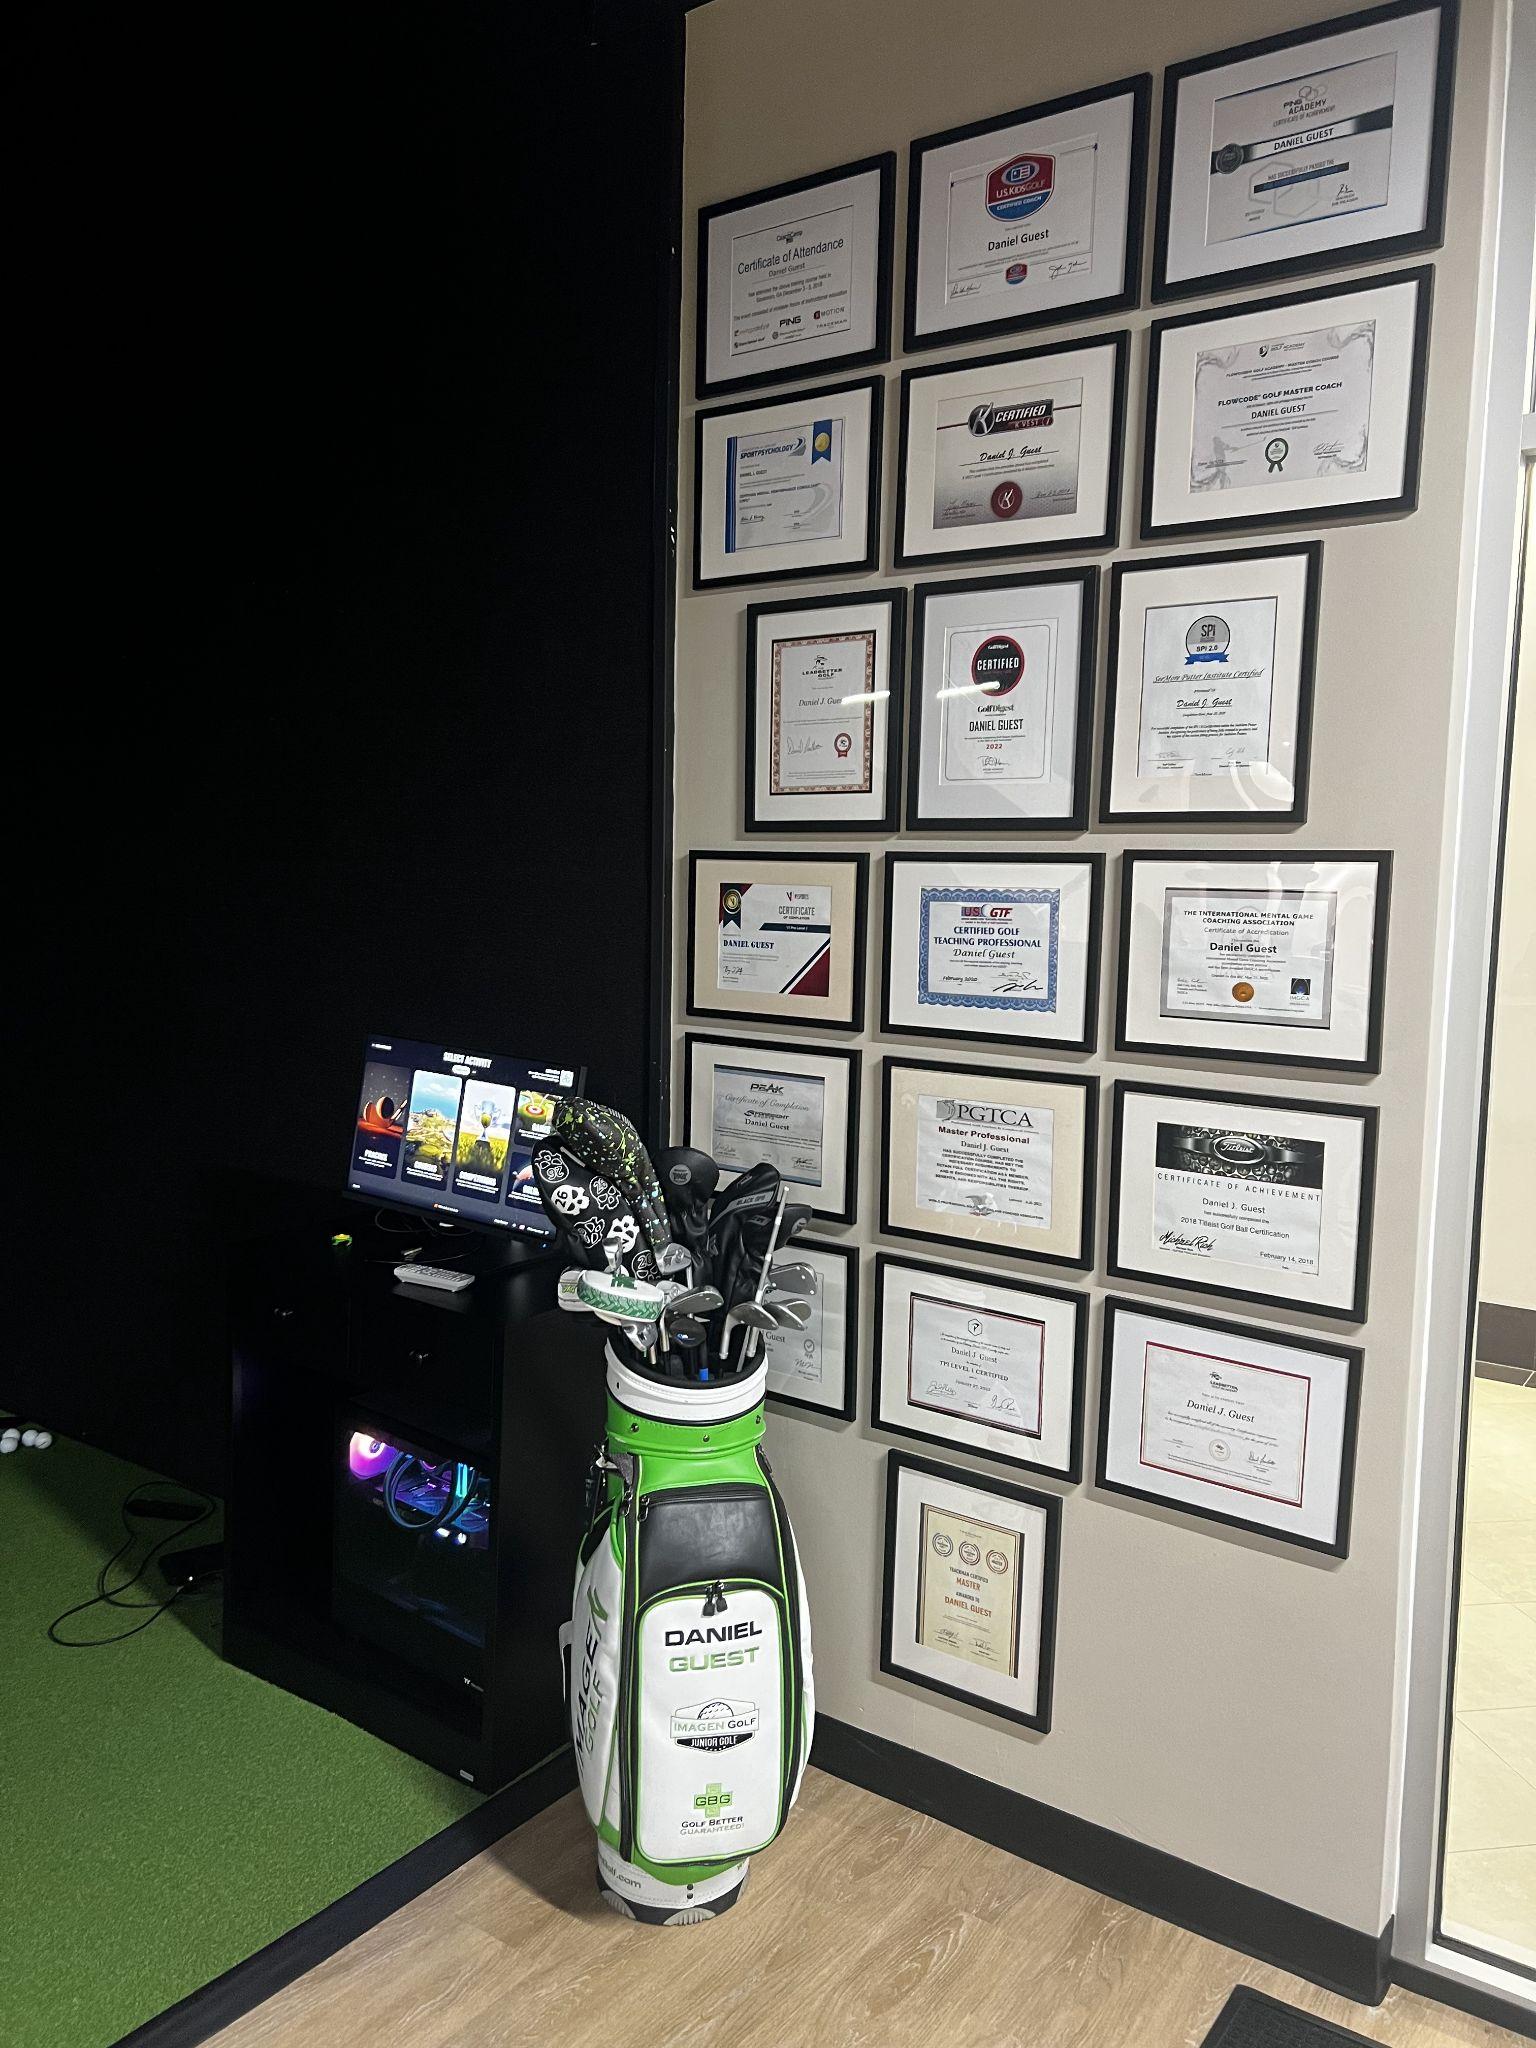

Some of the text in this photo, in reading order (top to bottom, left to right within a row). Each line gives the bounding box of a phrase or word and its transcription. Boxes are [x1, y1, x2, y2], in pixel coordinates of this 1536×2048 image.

[1283, 99, 1302, 109] PING
[1289, 99, 1327, 115] ACADEMY
[1274, 128, 1334, 150] DANIEL GUEST
[988, 229, 1049, 251] Daniel Guest
[738, 239, 844, 274] Certificate of Attendance
[769, 263, 805, 277] Daniel Guest
[820, 307, 845, 316] MOTION
[780, 316, 801, 327] PING
[1262, 391, 1282, 399] GOLF
[1283, 387, 1313, 396] MASTER
[1315, 382, 1342, 391] COACH
[996, 405, 1046, 423] CERTIFIED
[1251, 404, 1306, 419] DANIEL GUEST
[979, 451, 1005, 462] Daniel
[1020, 446, 1042, 458] Guest
[1201, 624, 1216, 637] SPI
[977, 657, 1019, 671] CERTIFIED
[799, 699, 819, 707] Daniel
[1212, 698, 1233, 707] Guest
[969, 719, 1024, 732] DANIEL GUEST
[778, 906, 815, 916] CERTIFICATE
[954, 927, 1020, 936] CERTIFIED GOLF
[723, 940, 749, 948] DANIEL
[934, 937, 1042, 948] TEACHING PROFESSIONAL
[1210, 942, 1277, 954] Daniel Guest
[953, 948, 1015, 959] Daniel Guest
[443, 1051, 492, 1069] SELECT ACTIVITY
[750, 1083, 784, 1093] PEAK
[724, 1092, 760, 1105] Certificate
[770, 1100, 809, 1112] Completion
[958, 1105, 1034, 1128] PGTCA
[745, 1119, 789, 1130] Daniel Guest
[938, 1126, 1030, 1144] Master Professional
[961, 1141, 982, 1149] Daniel
[990, 1145, 1009, 1153] Guest
[1157, 1172, 1221, 1188] CERTIFICATE
[1245, 1185, 1320, 1202] ACHIEVEMENT
[1202, 1198, 1229, 1209] Daniel
[1241, 1204, 1266, 1214] Guest
[1198, 1219, 1219, 1229] Titleist
[1221, 1222, 1234, 1231] Golf
[1236, 1224, 1248, 1233] Ball
[1249, 1227, 1290, 1239] Certification
[1260, 1251, 1286, 1261] February
[765, 1331, 786, 1343] Guest
[951, 1347, 971, 1357] Daniel
[980, 1354, 997, 1363] Guest
[951, 1363, 969, 1372] LEVEL
[976, 1369, 1009, 1381] CERTIFIED
[1187, 1399, 1255, 1423] Daniel J. Guest
[956, 1577, 981, 1591] MASTER
[944, 1596, 992, 1618] DANIEL GUEST
[665, 1621, 762, 1646] DANIEL
[669, 1646, 760, 1672] GUEST
[584, 1670, 605, 1755] GOLF
[674, 1722, 725, 1732] IMAGEN
[691, 1735, 737, 1747] JUNIOR GOLF
[695, 1794, 731, 1806] GBG
